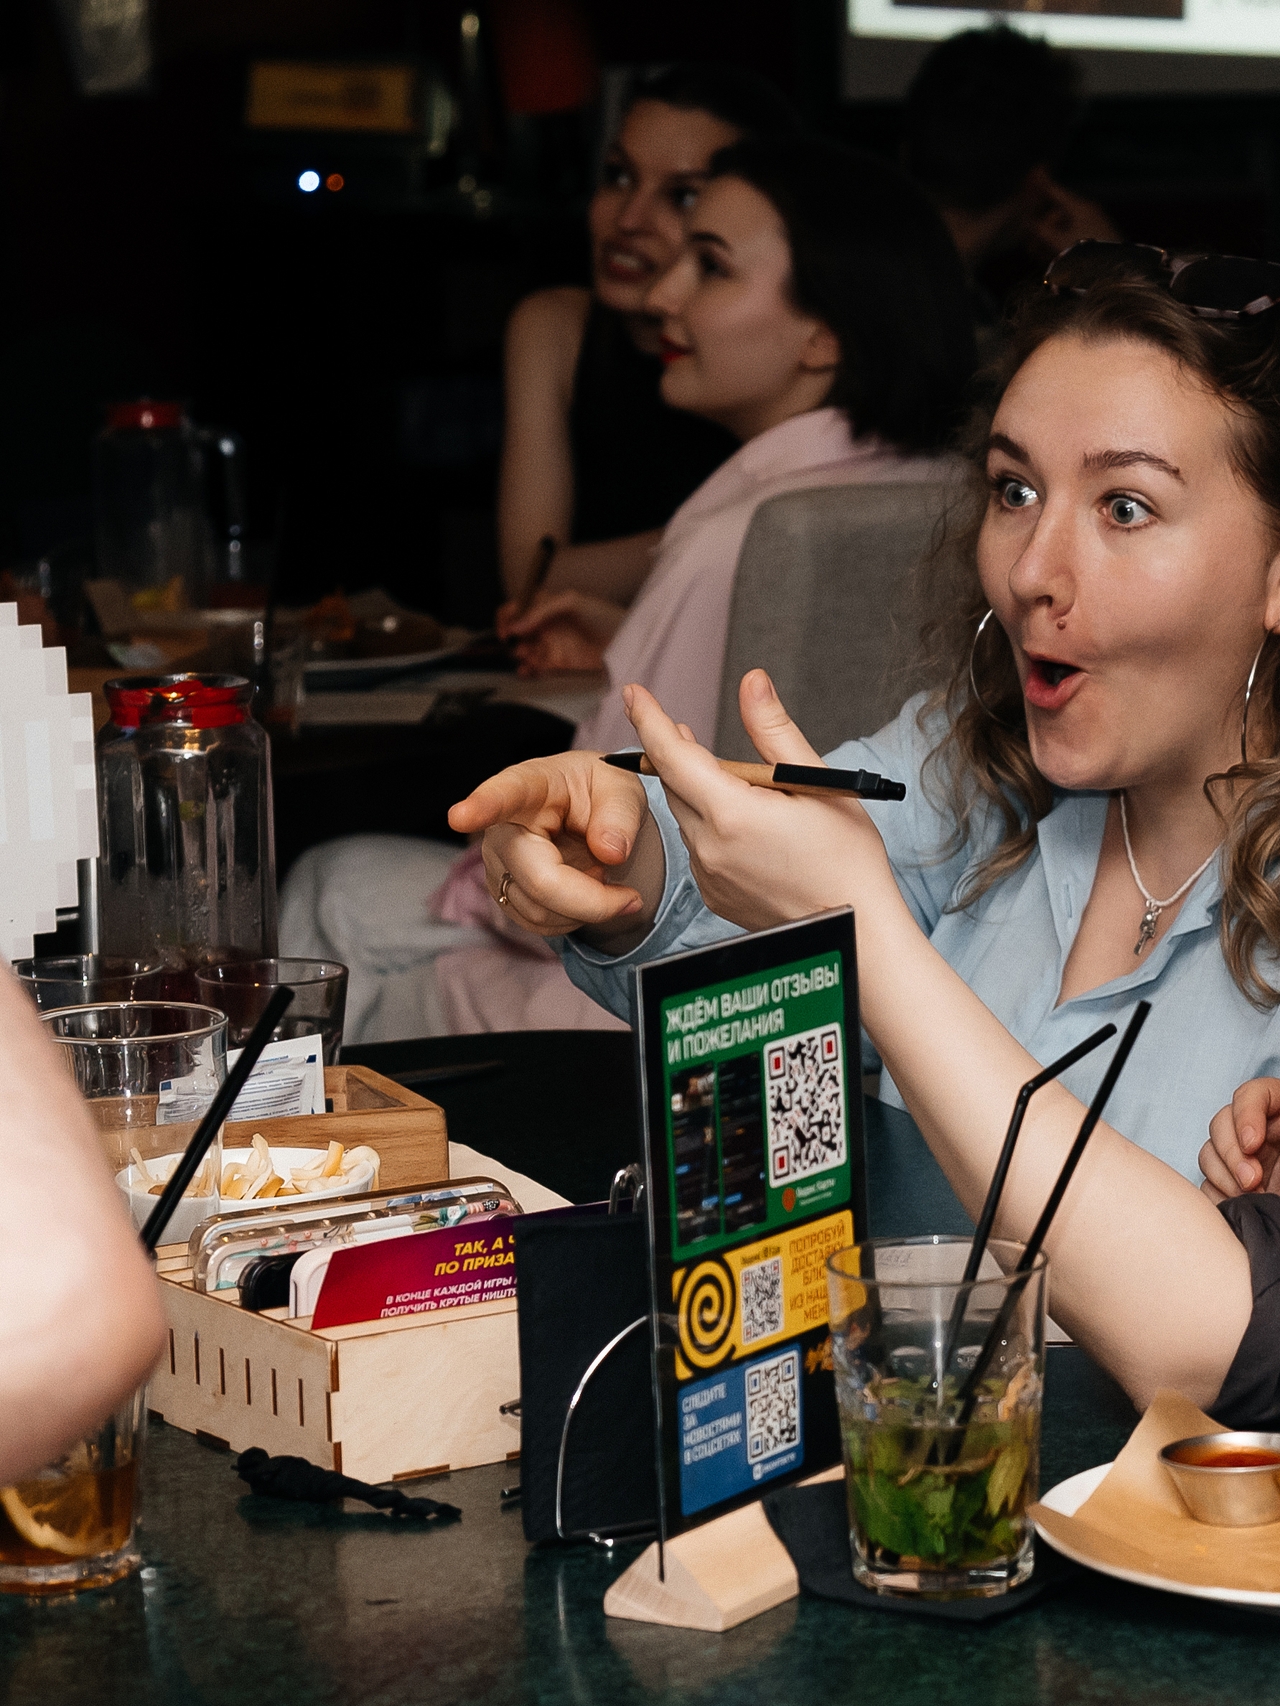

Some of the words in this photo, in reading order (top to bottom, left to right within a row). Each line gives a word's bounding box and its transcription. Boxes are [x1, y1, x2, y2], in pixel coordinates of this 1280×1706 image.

[665, 995, 719, 1034] ЖДЁМ
[720, 982, 770, 1018] ВАШИ
[771, 962, 840, 1003] ОТЗЫВЫ
[667, 1037, 681, 1065] И
[683, 1007, 785, 1060] ПОЖЕЛАНИЯ
[454, 1239, 488, 1257] ТАК,
[492, 1236, 503, 1250] А
[789, 1219, 845, 1258] ПОПРОБУЙ
[434, 1260, 460, 1276] ПО
[462, 1252, 515, 1272] ПРИЗА
[380, 1300, 438, 1318] ПОЛУЧИТЬ
[439, 1293, 480, 1309] КРУТЫЕ
[481, 1287, 517, 1302] НИШТЯ
[386, 1295, 394, 1305] В
[395, 1288, 432, 1303] КОНЦЕ
[433, 1280, 481, 1295] КАЖДОЙ
[484, 1276, 513, 1289] ИГРЫ
